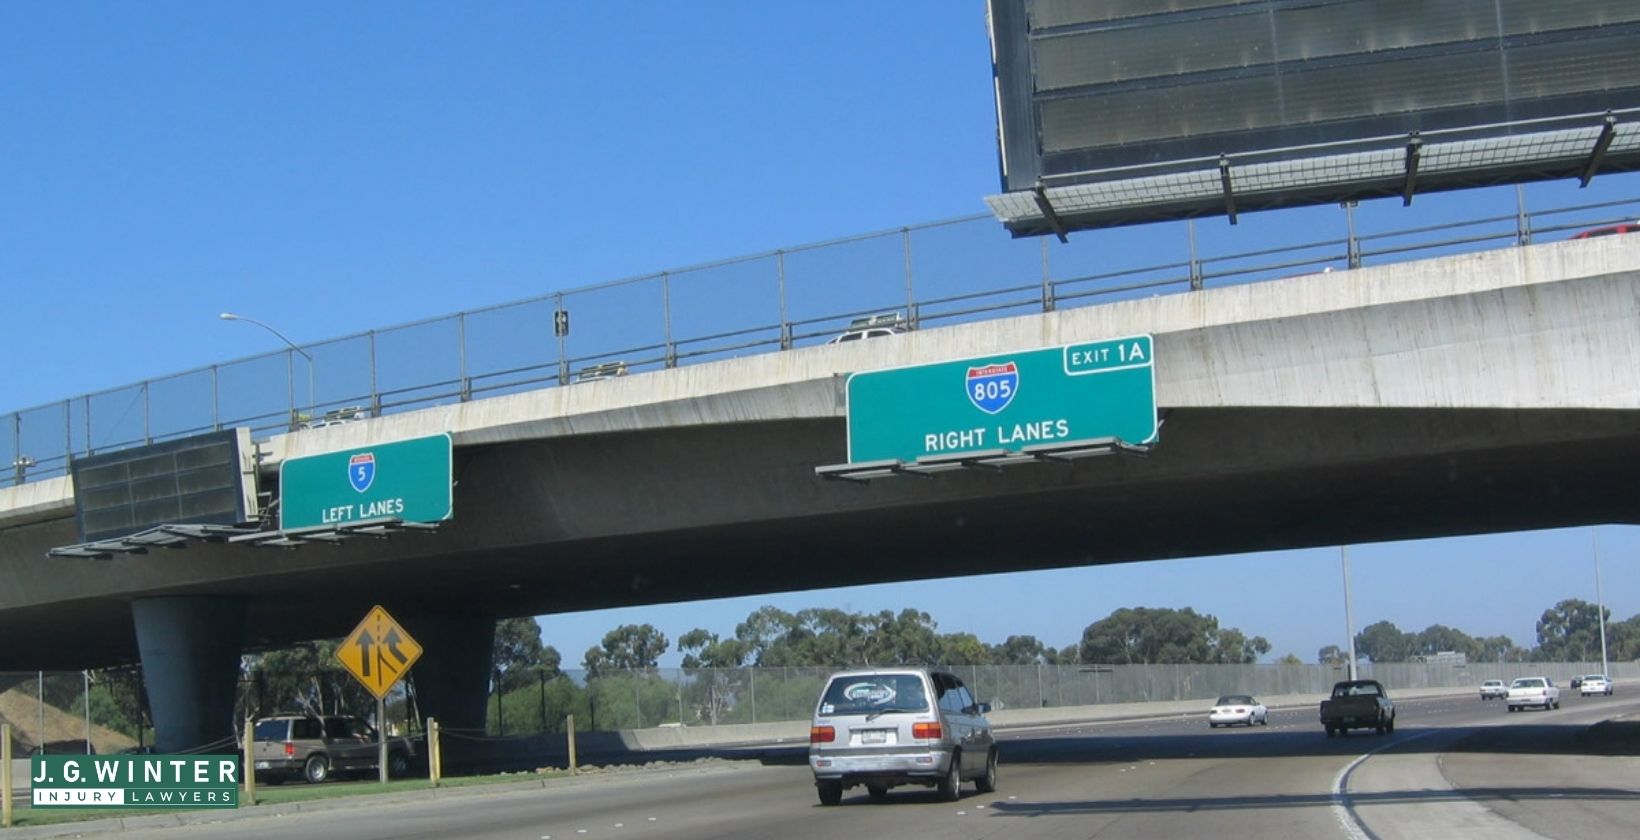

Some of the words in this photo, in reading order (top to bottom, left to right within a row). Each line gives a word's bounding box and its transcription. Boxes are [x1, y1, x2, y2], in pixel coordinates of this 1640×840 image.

[1072, 348, 1110, 365] EXIT
[1118, 342, 1145, 362] 1A
[975, 380, 1011, 401] 805
[925, 428, 986, 452] RIGHT
[998, 419, 1069, 443] LANES
[358, 466, 366, 481] 5
[322, 505, 353, 523] LEFT
[360, 498, 404, 518] LANES
